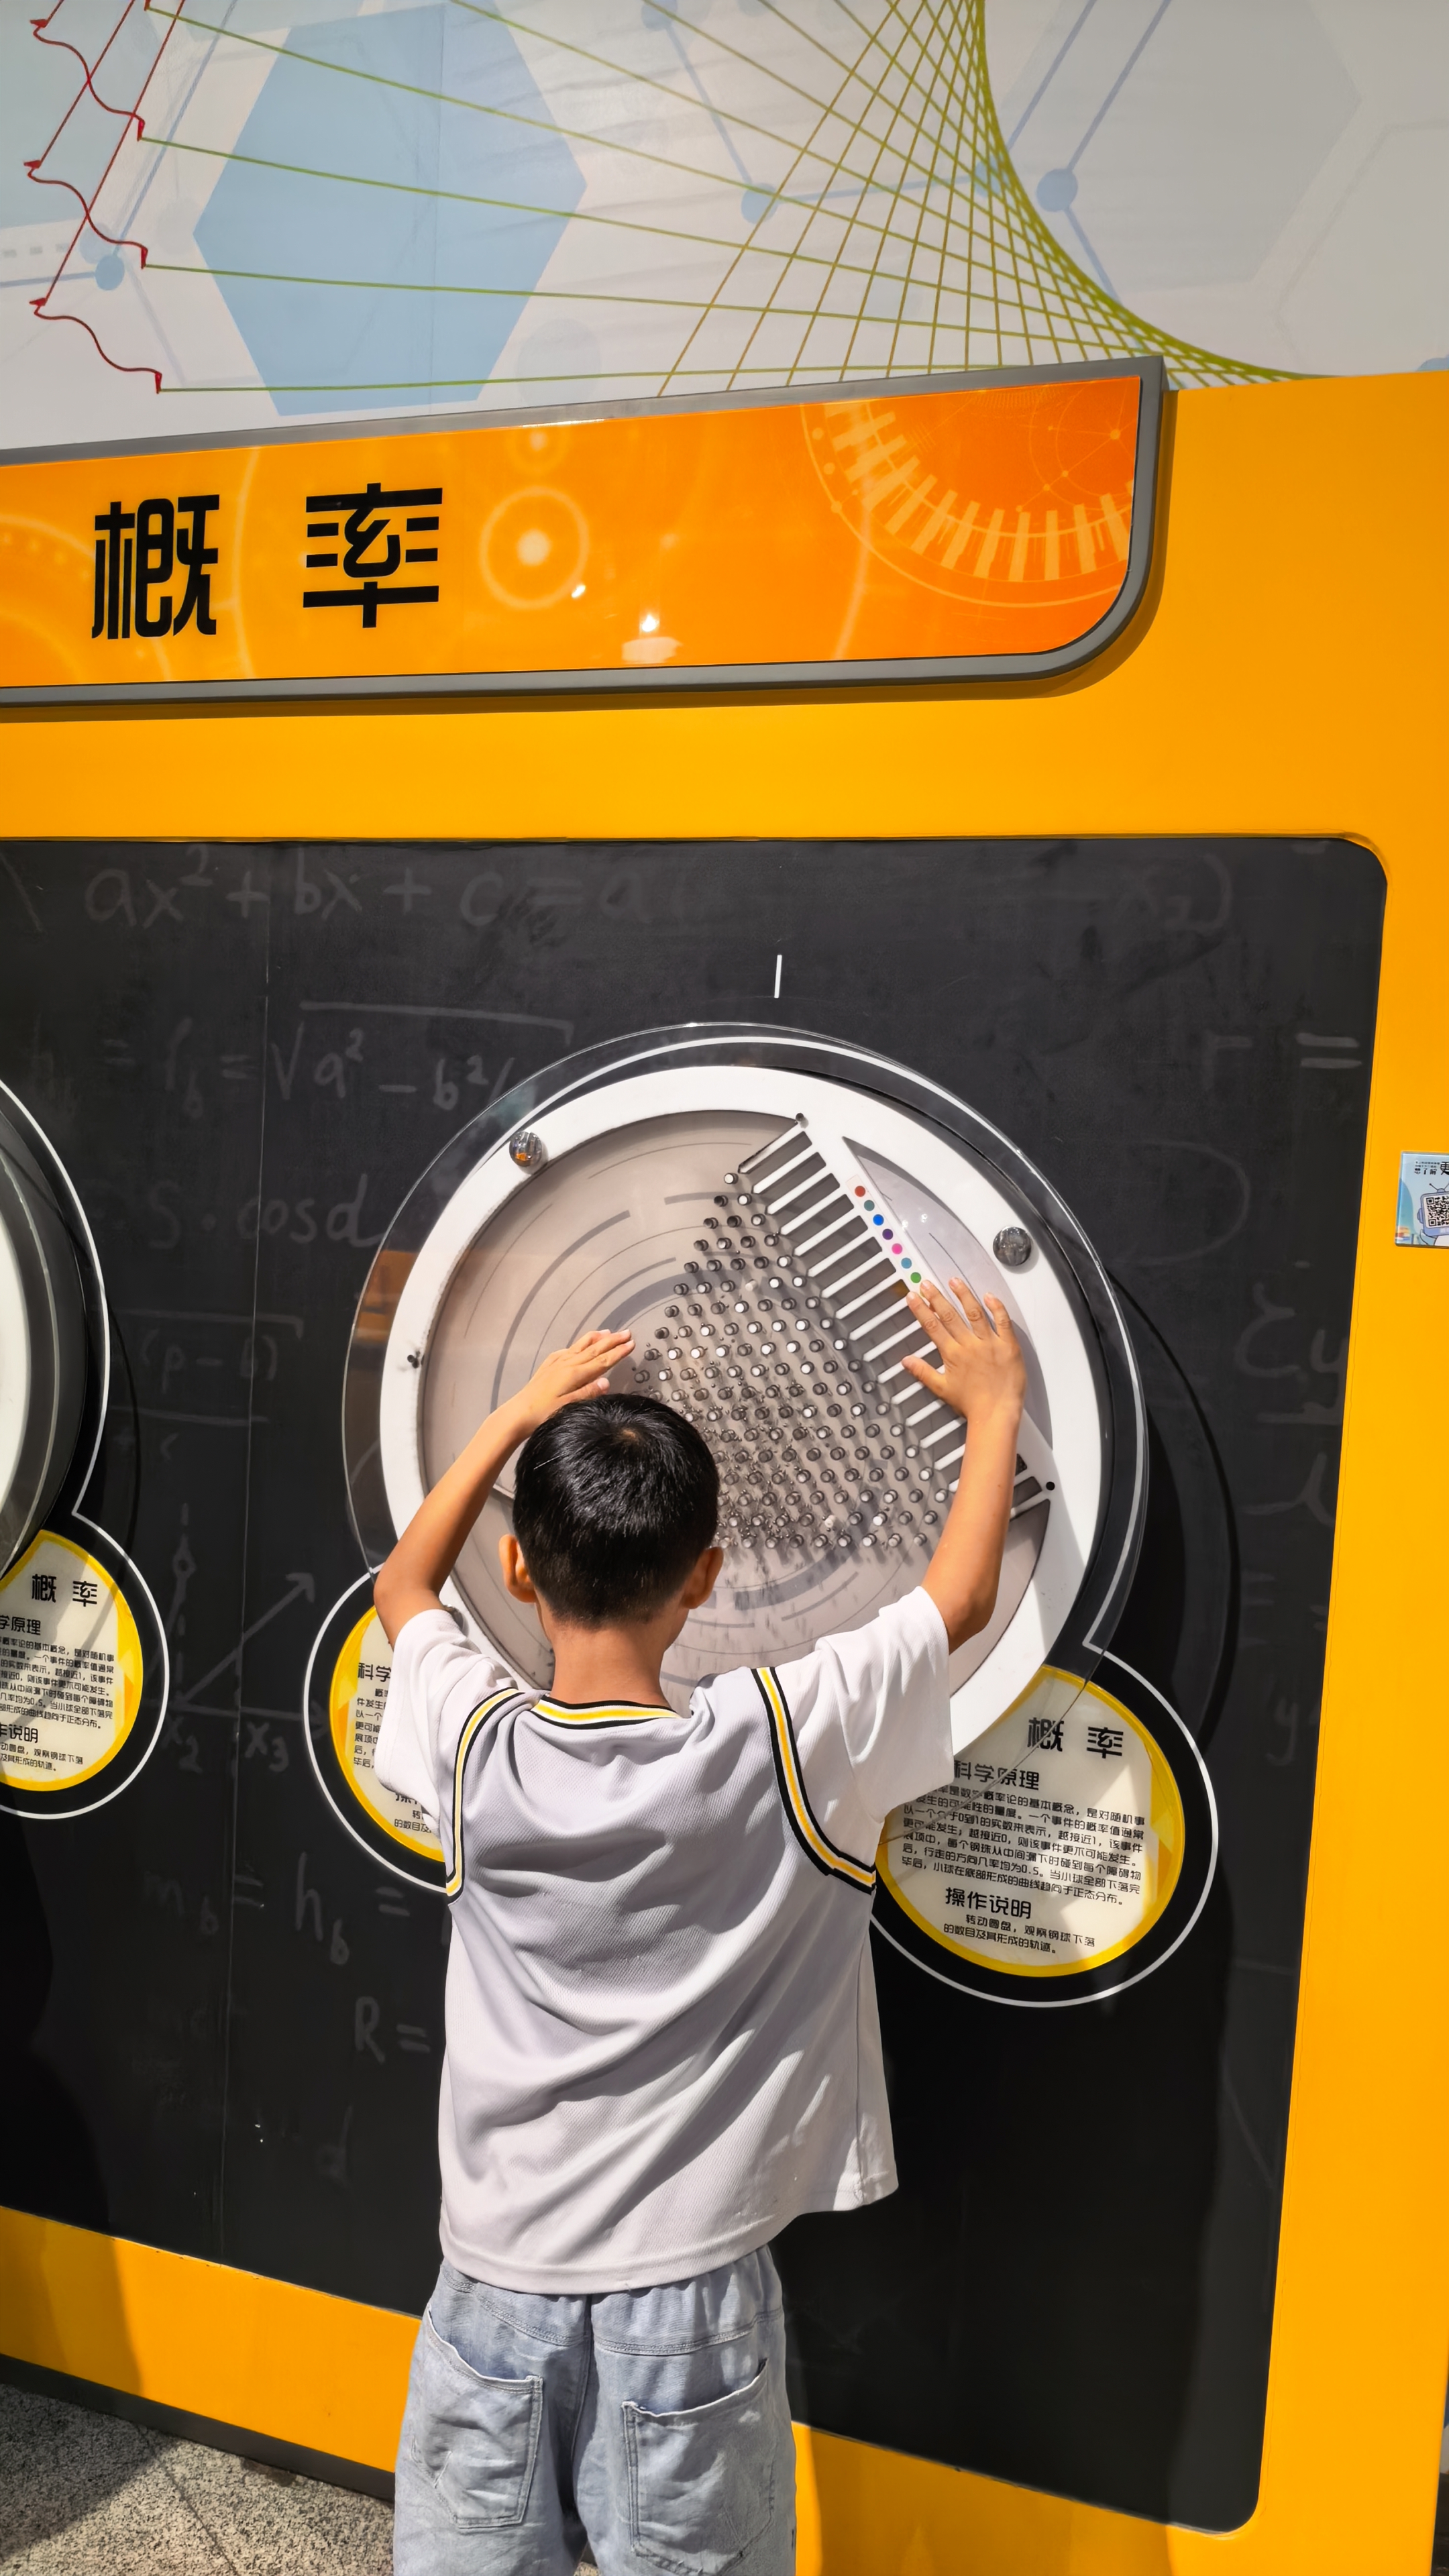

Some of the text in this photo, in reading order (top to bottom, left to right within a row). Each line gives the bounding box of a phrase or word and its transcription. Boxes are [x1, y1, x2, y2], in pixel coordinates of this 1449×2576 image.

[92, 482, 443, 640] 概率
[32, 1574, 98, 1607] 概率
[1027, 1716, 1124, 1759] 概率
[954, 1760, 1039, 1790] 科学原理
[945, 1886, 1032, 1920] 操作说明
